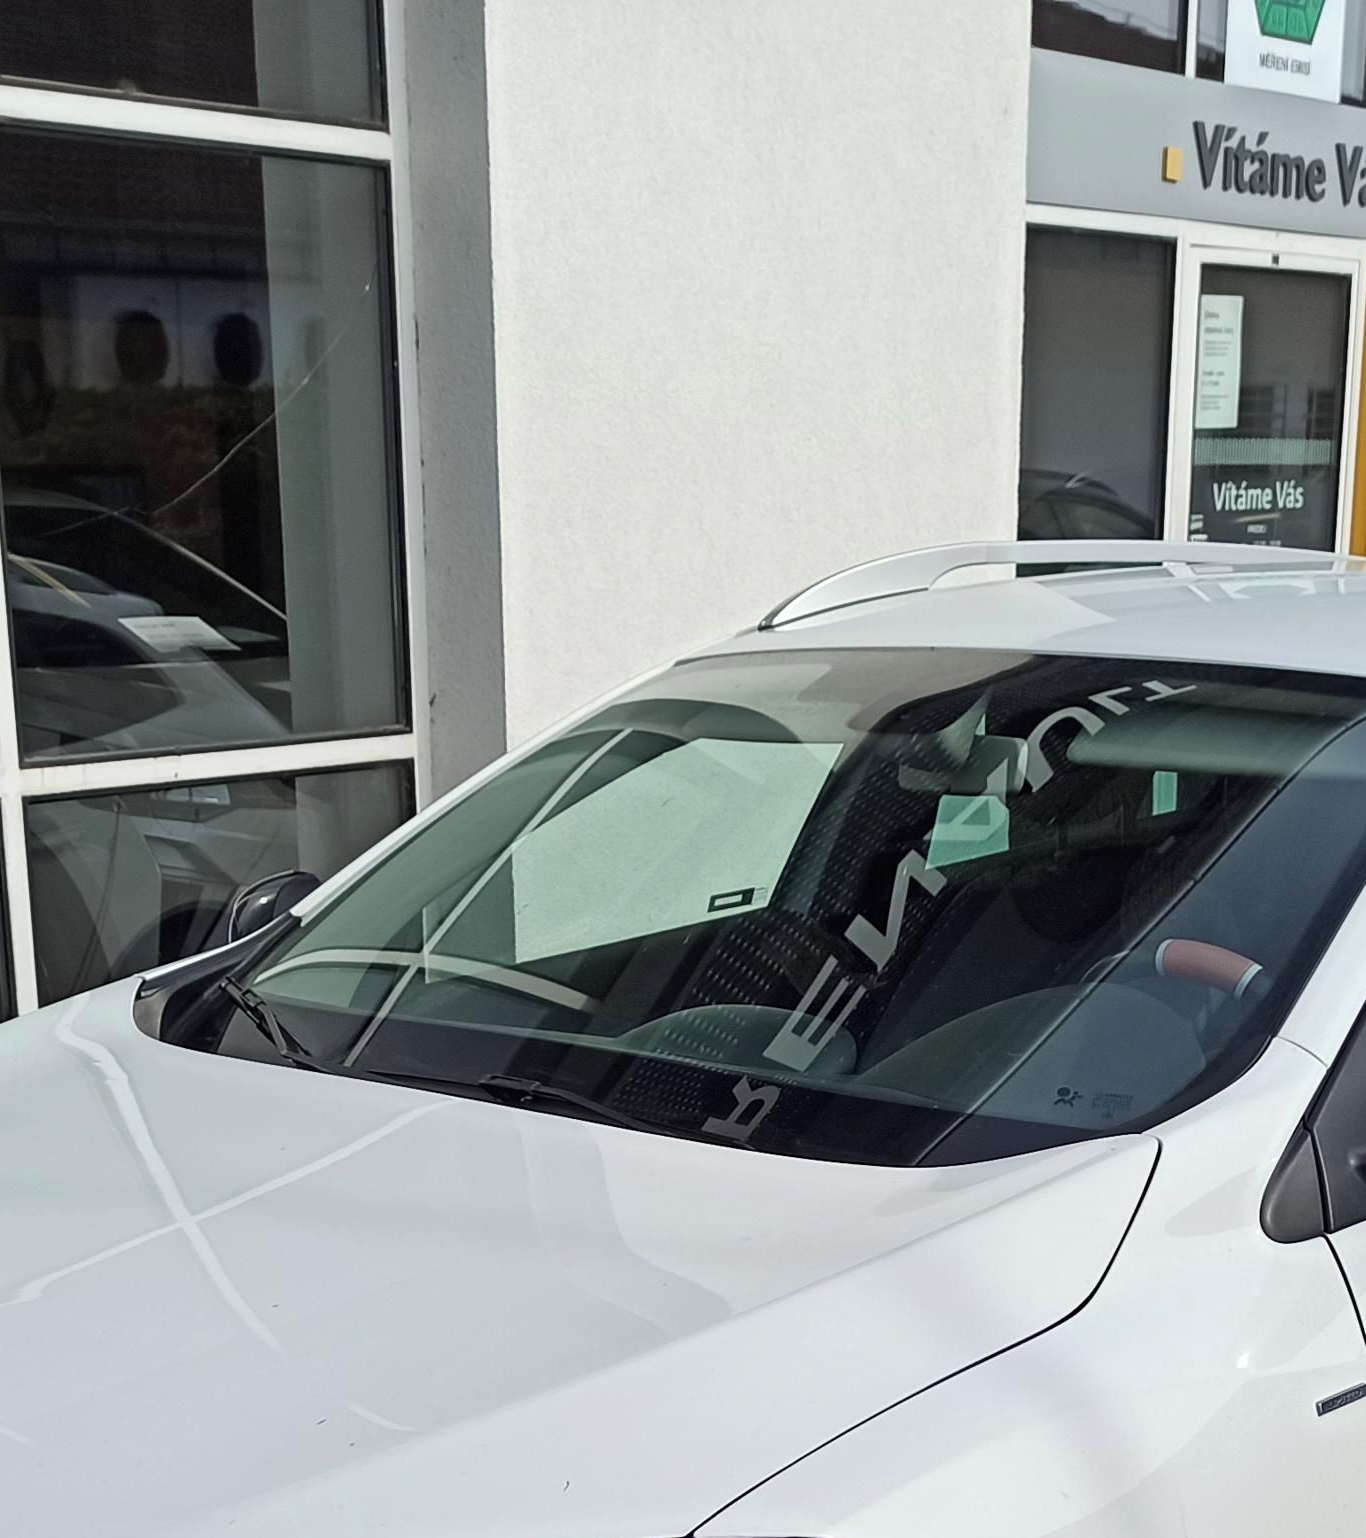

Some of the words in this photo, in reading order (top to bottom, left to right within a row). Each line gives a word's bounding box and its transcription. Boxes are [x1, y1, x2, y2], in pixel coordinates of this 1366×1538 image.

[1192, 120, 1327, 203] Vítáme
[1212, 480, 1273, 512] Vítáme
[1276, 480, 1304, 509] Vás
